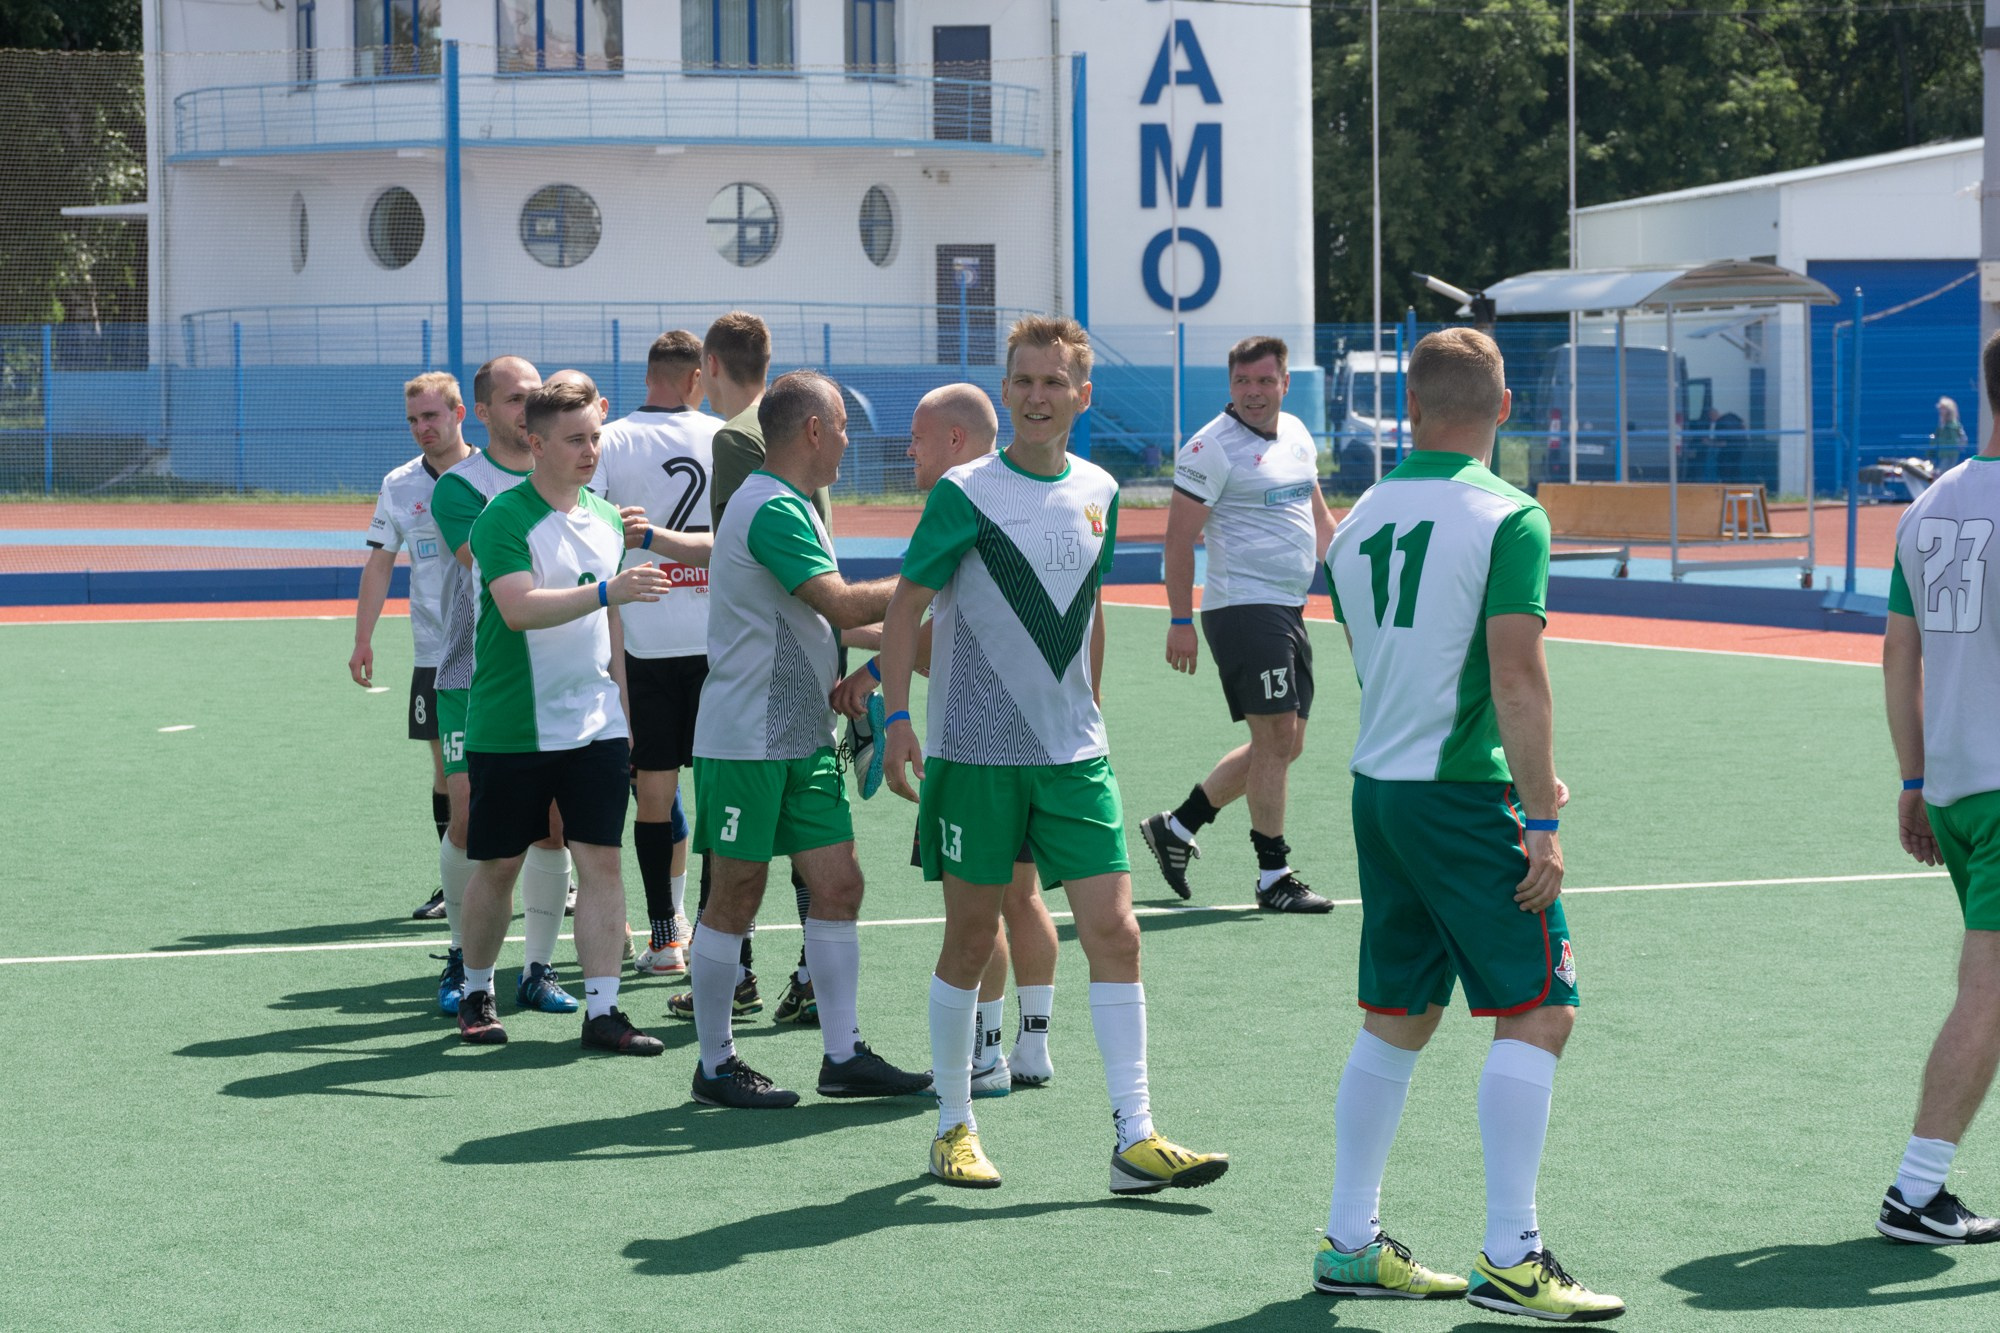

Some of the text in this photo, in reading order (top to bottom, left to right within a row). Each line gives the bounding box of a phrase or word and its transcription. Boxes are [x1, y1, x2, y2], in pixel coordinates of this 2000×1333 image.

[1139, 0, 1223, 312] АМО
[662, 457, 709, 532] 2
[1045, 531, 1081, 571] 13
[1359, 520, 1435, 629] 11
[1916, 517, 1995, 633] 23
[1260, 667, 1288, 699] 13
[415, 695, 426, 724] 8
[443, 731, 464, 763] 45
[720, 806, 741, 842] 3
[938, 817, 963, 863] 13
